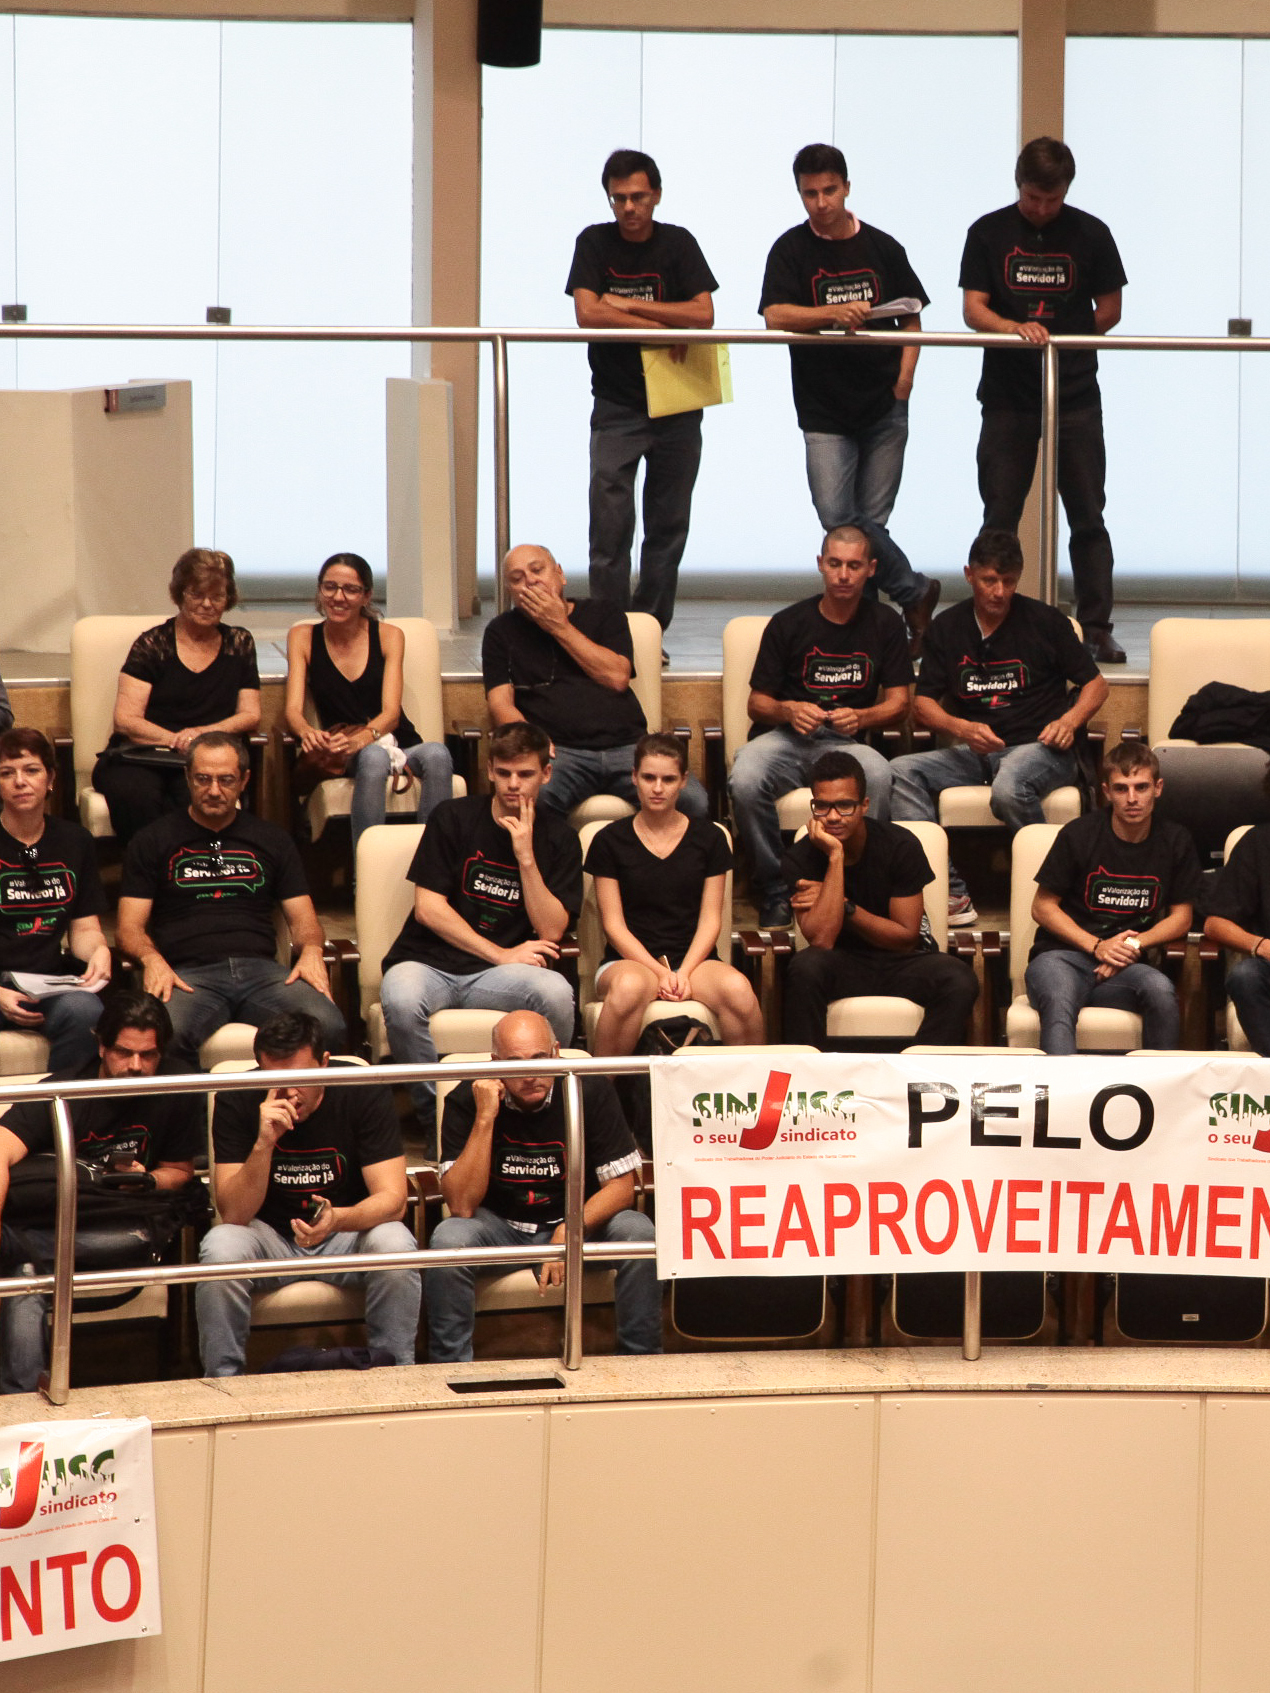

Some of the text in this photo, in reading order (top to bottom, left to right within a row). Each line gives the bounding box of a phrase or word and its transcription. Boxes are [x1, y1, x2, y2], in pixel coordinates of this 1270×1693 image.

[1016, 272, 1054, 283] Servidor
[814, 671, 862, 682] Servidor Já
[967, 680, 1017, 691] Servidor Já
[56, 886, 66, 900] Já
[509, 888, 519, 900] Já
[1098, 894, 1149, 907] Servidor Já
[908, 1082, 1155, 1151] PELO
[693, 1129, 857, 1145] o seu sindicato
[1208, 1133, 1219, 1144] o
[1223, 1134, 1251, 1145] seu
[547, 1155, 556, 1163] do
[277, 1163, 320, 1173] #Valorização
[501, 1163, 560, 1177] Servidor Já
[274, 1171, 334, 1184] Servidor Já
[40, 1491, 117, 1516] sindicato
[0, 1544, 141, 1641] NTO
